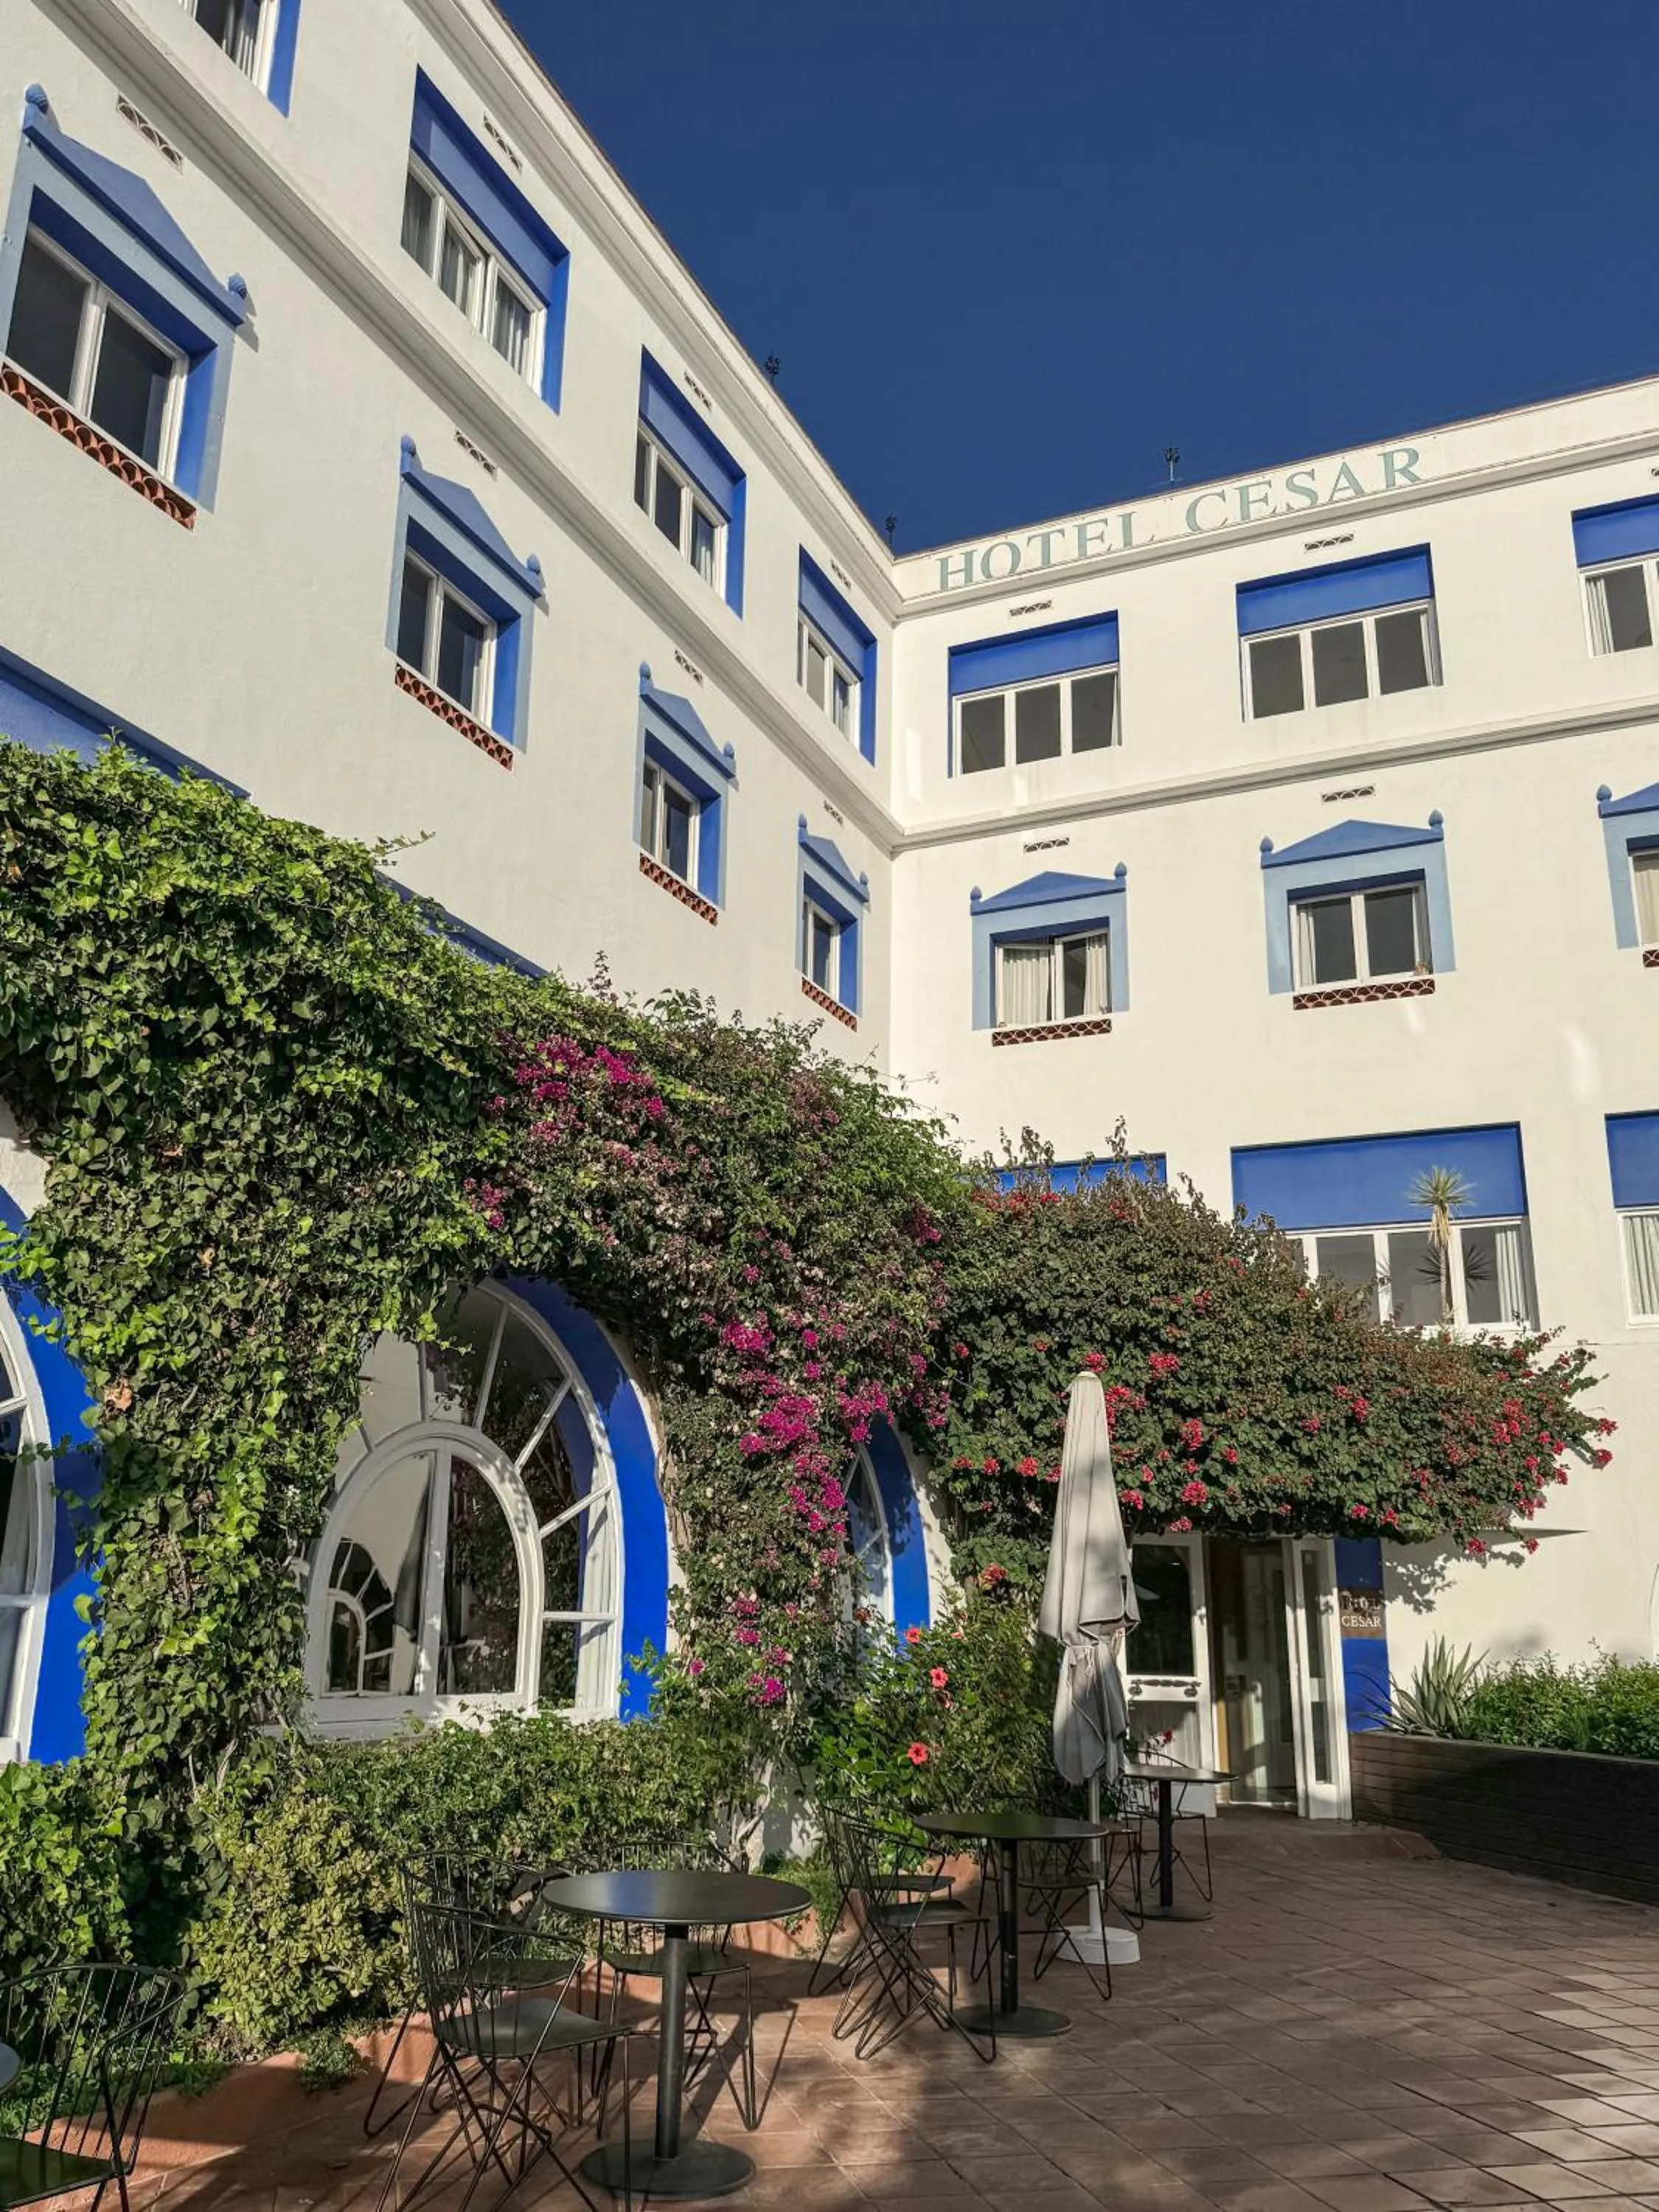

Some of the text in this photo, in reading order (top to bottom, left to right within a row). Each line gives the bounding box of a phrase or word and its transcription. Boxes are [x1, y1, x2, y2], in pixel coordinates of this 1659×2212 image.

[935, 447, 1423, 591] HOTEL CESAR
[1341, 1615, 1381, 1628] CESAR
